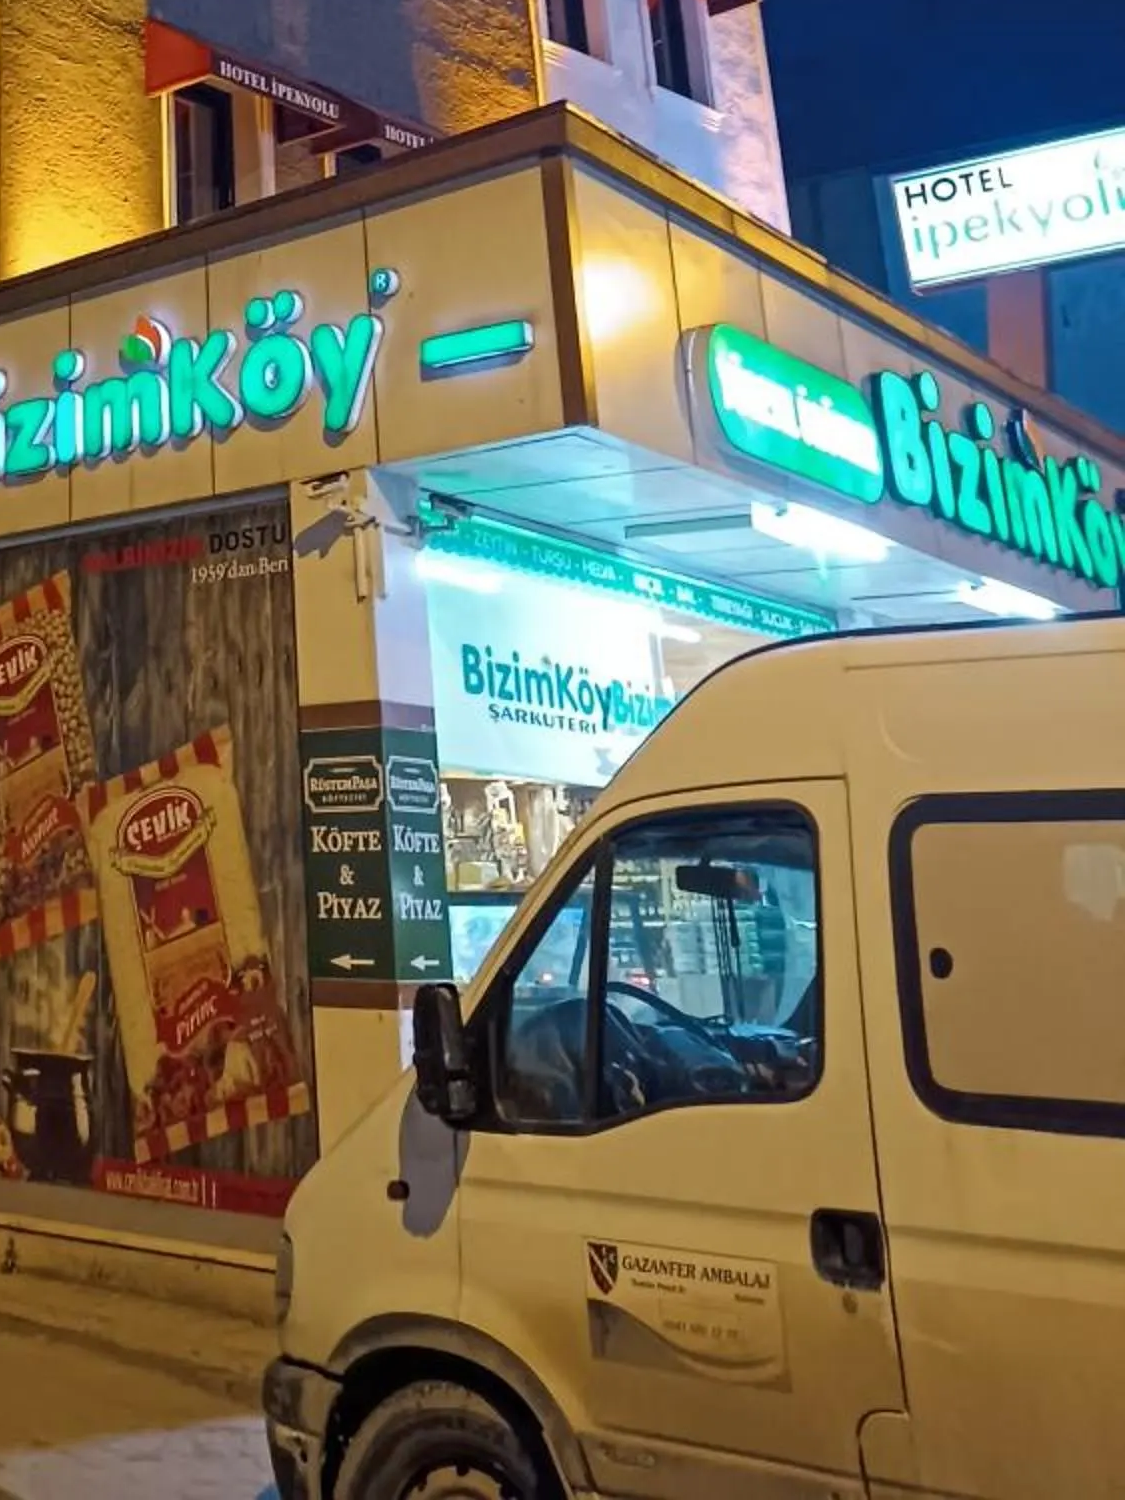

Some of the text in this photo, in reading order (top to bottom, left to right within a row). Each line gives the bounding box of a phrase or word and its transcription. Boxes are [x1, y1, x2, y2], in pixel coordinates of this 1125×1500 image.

[220, 60, 269, 96] HOTEL
[904, 166, 1013, 209] HOTEL
[209, 522, 287, 554] DOSTU
[258, 555, 288, 576] Beri
[462, 643, 613, 731] BizimKöy
[126, 796, 192, 851] ÇEVİK
[310, 825, 382, 853] KÖFTE
[392, 824, 441, 854] KÖFTE
[339, 863, 355, 886] &
[413, 864, 425, 886] &
[316, 891, 383, 919] PİYAZ
[398, 891, 444, 921] PİYAZ
[621, 1254, 696, 1281] GAZANFER
[699, 1267, 771, 1290] AMBALAJ
